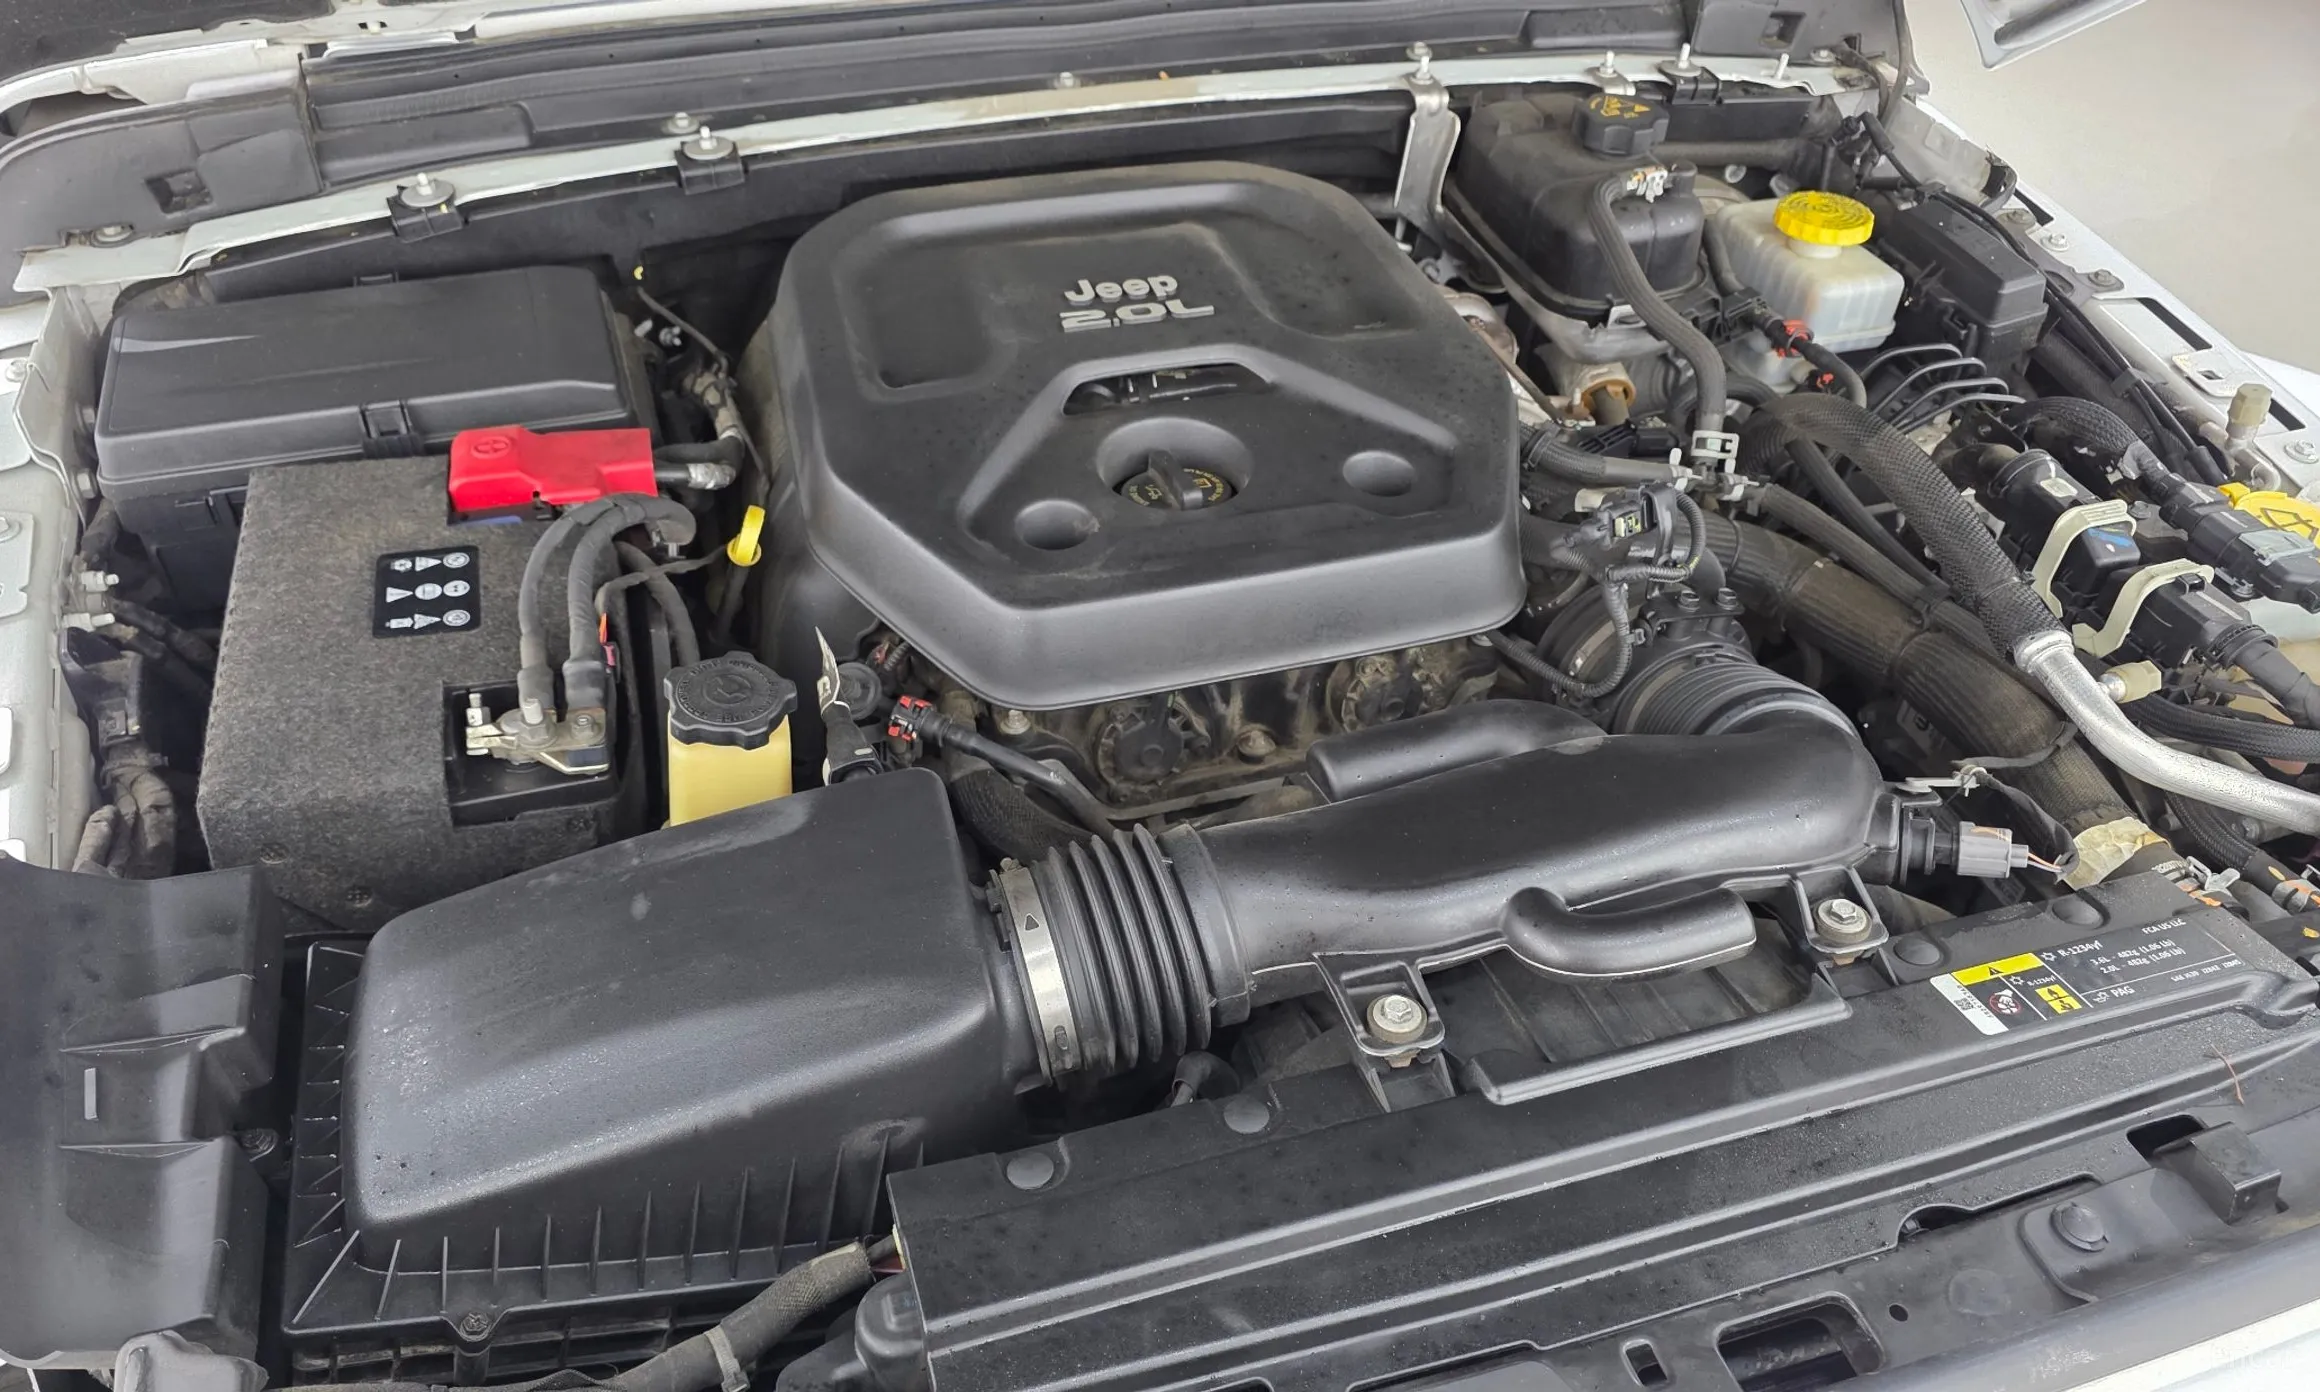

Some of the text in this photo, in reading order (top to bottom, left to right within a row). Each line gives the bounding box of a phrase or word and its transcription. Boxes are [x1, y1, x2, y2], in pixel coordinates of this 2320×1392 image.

[1064, 275, 1178, 305] Jeep
[1059, 299, 1215, 332] 2.0L
[2142, 926, 2160, 934] FCA
[2158, 922, 2172, 930] US
[2057, 940, 2103, 957] R-1234yf
[2090, 956, 2111, 965] 3.6L
[2100, 964, 2120, 974] 2.0L
[2110, 985, 2135, 998] PAG
